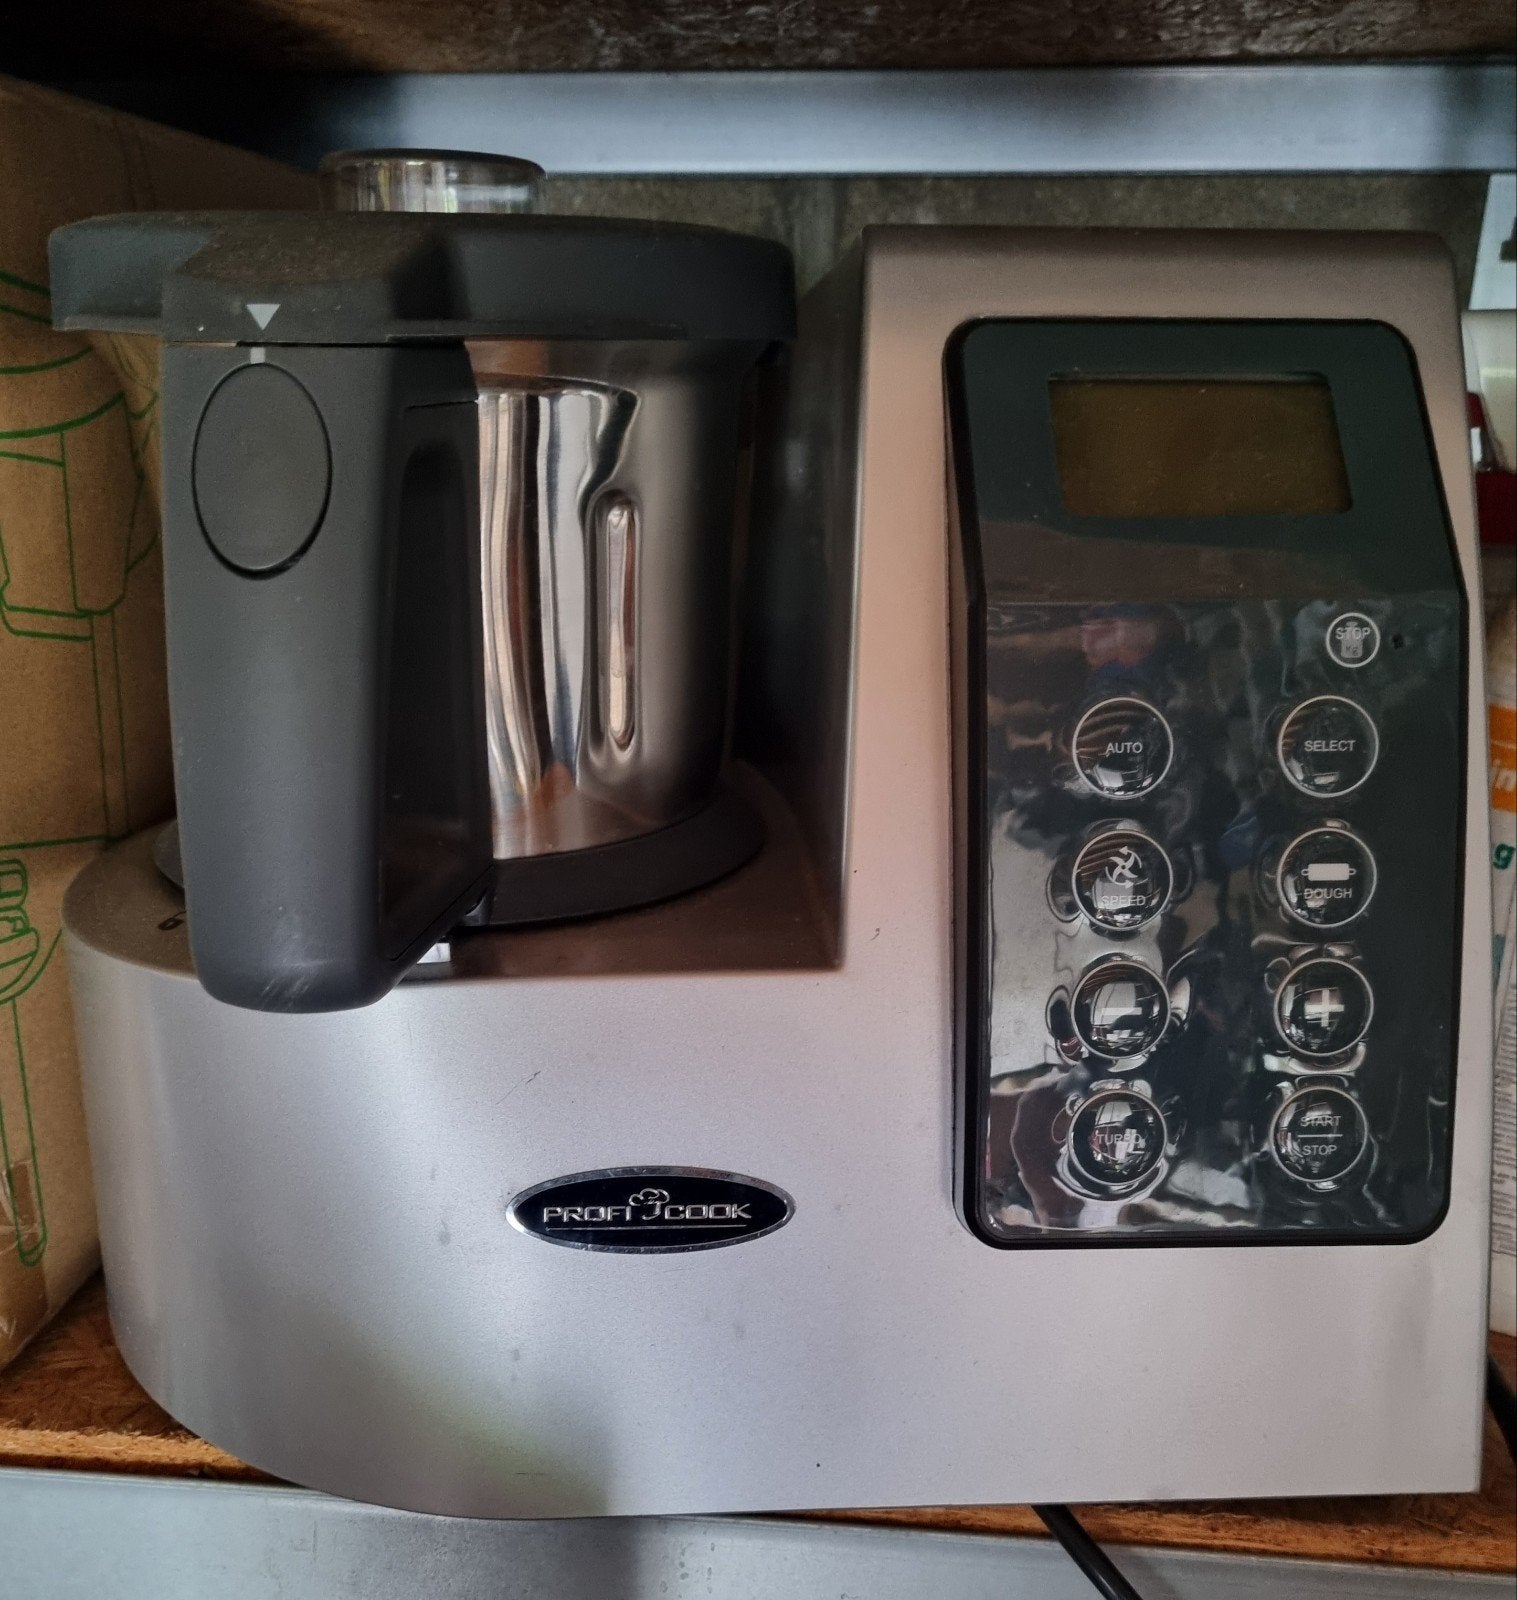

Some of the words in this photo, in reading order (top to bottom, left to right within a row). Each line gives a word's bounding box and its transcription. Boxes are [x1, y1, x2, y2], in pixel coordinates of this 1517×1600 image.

[1105, 741, 1143, 754] AUTO
[1304, 740, 1355, 753] SELECT
[1303, 888, 1352, 900] DOUGH
[1101, 895, 1146, 907] SPEED
[1299, 1115, 1341, 1127] START
[1303, 1144, 1338, 1156] STOP
[545, 1207, 631, 1223] PROFI
[664, 1203, 752, 1220] COOK
